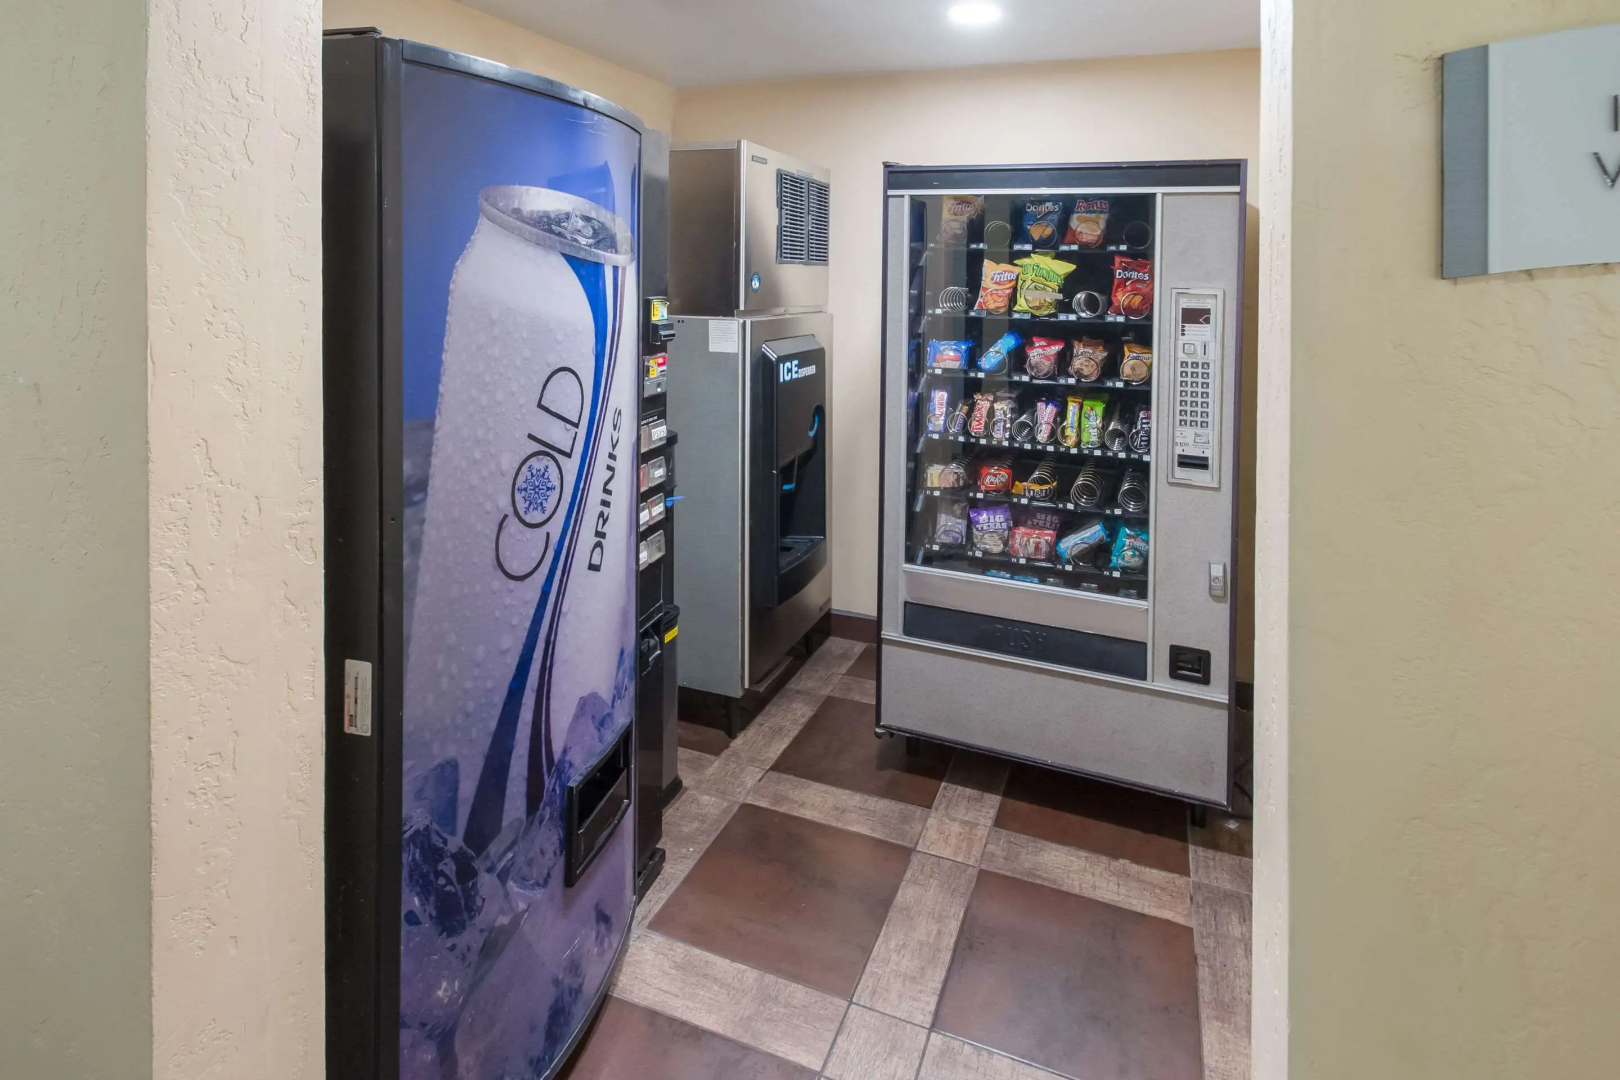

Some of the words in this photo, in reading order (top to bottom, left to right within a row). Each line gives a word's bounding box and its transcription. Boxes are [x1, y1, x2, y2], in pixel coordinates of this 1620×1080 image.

[1025, 202, 1059, 213] Doritos
[991, 269, 1017, 283] Fritos
[1115, 269, 1149, 280] Doritos
[780, 359, 799, 383] ICE
[495, 366, 584, 582] COLD
[587, 407, 622, 572] DRINKS
[979, 514, 1005, 524] BIG
[975, 522, 1008, 532] TEXAS
